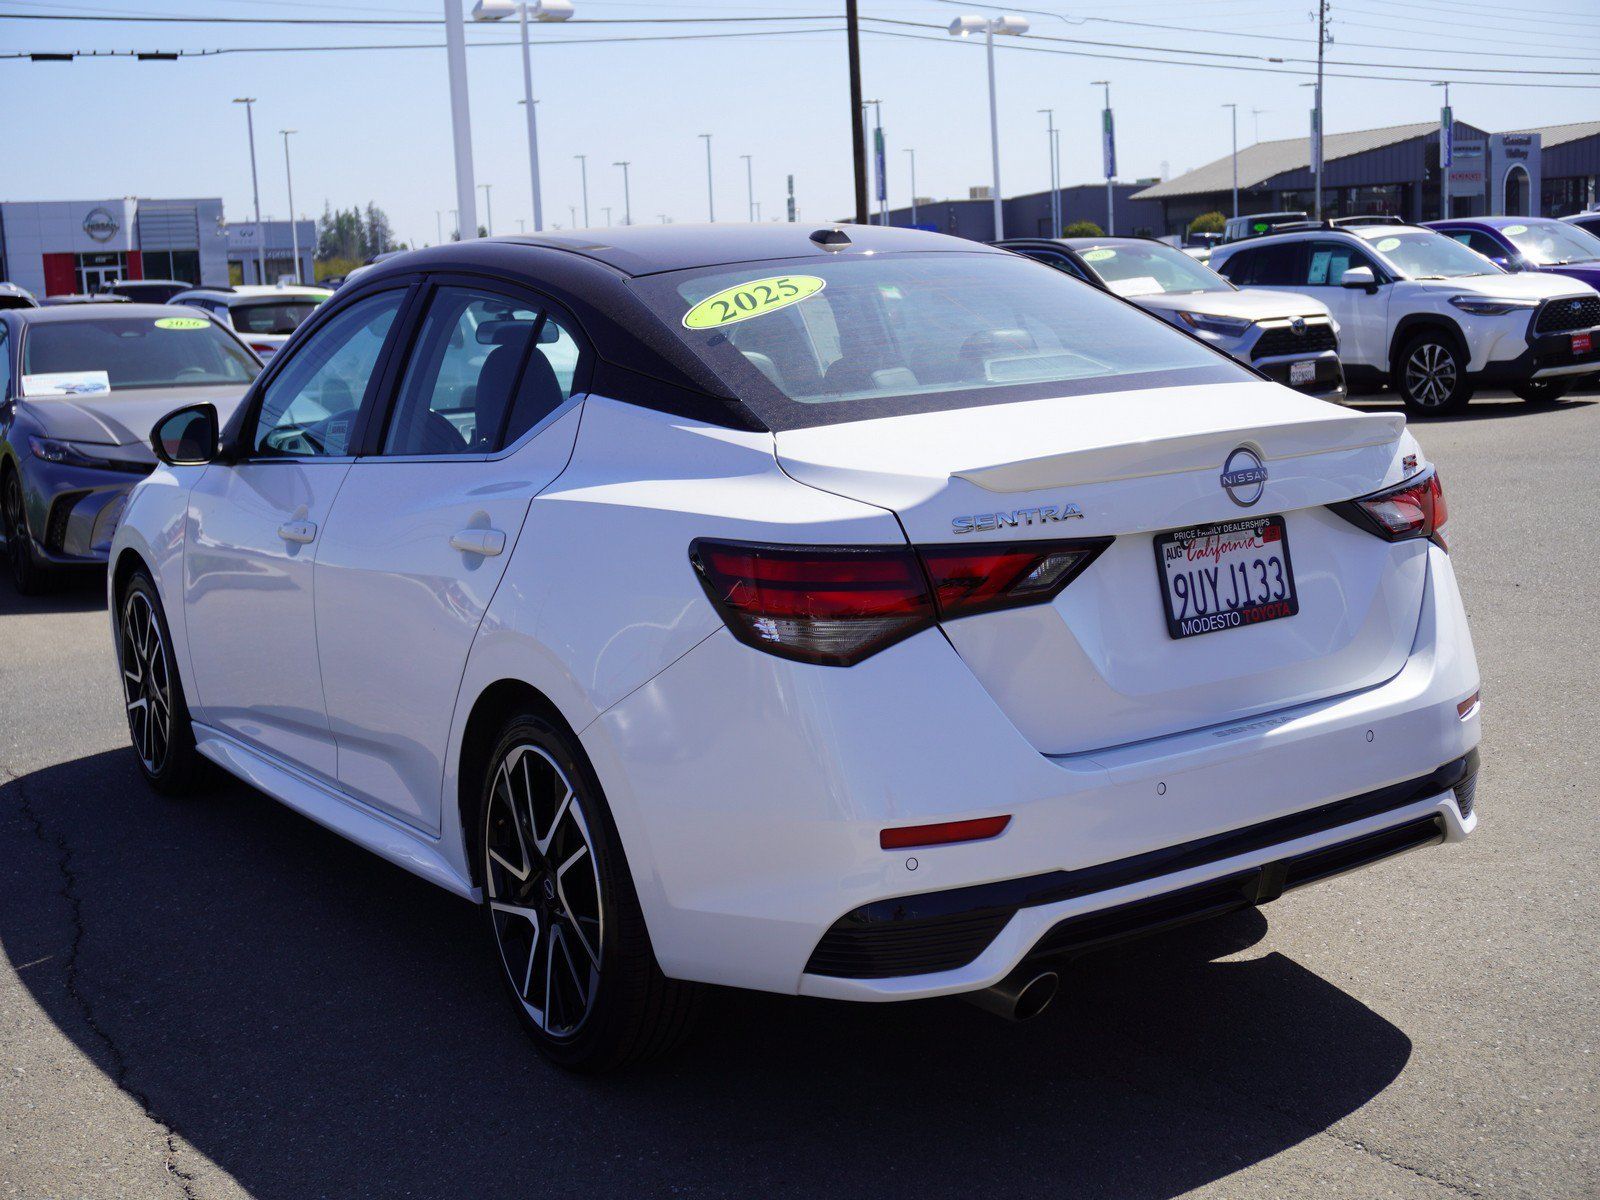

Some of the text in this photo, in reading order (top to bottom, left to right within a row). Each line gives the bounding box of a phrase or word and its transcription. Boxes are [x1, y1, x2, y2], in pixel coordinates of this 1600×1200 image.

[710, 278, 799, 323] 2025
[1222, 470, 1268, 485] NISSAN
[951, 502, 1085, 535] SENTRA
[1174, 528, 1199, 541] PRICE
[1223, 518, 1271, 534] DEALERSHIPS
[1166, 545, 1183, 561] AUG
[1186, 534, 1264, 563] California
[1173, 556, 1286, 619] 9UYJ133
[1181, 602, 1291, 636] MODESTO TOYOTA
